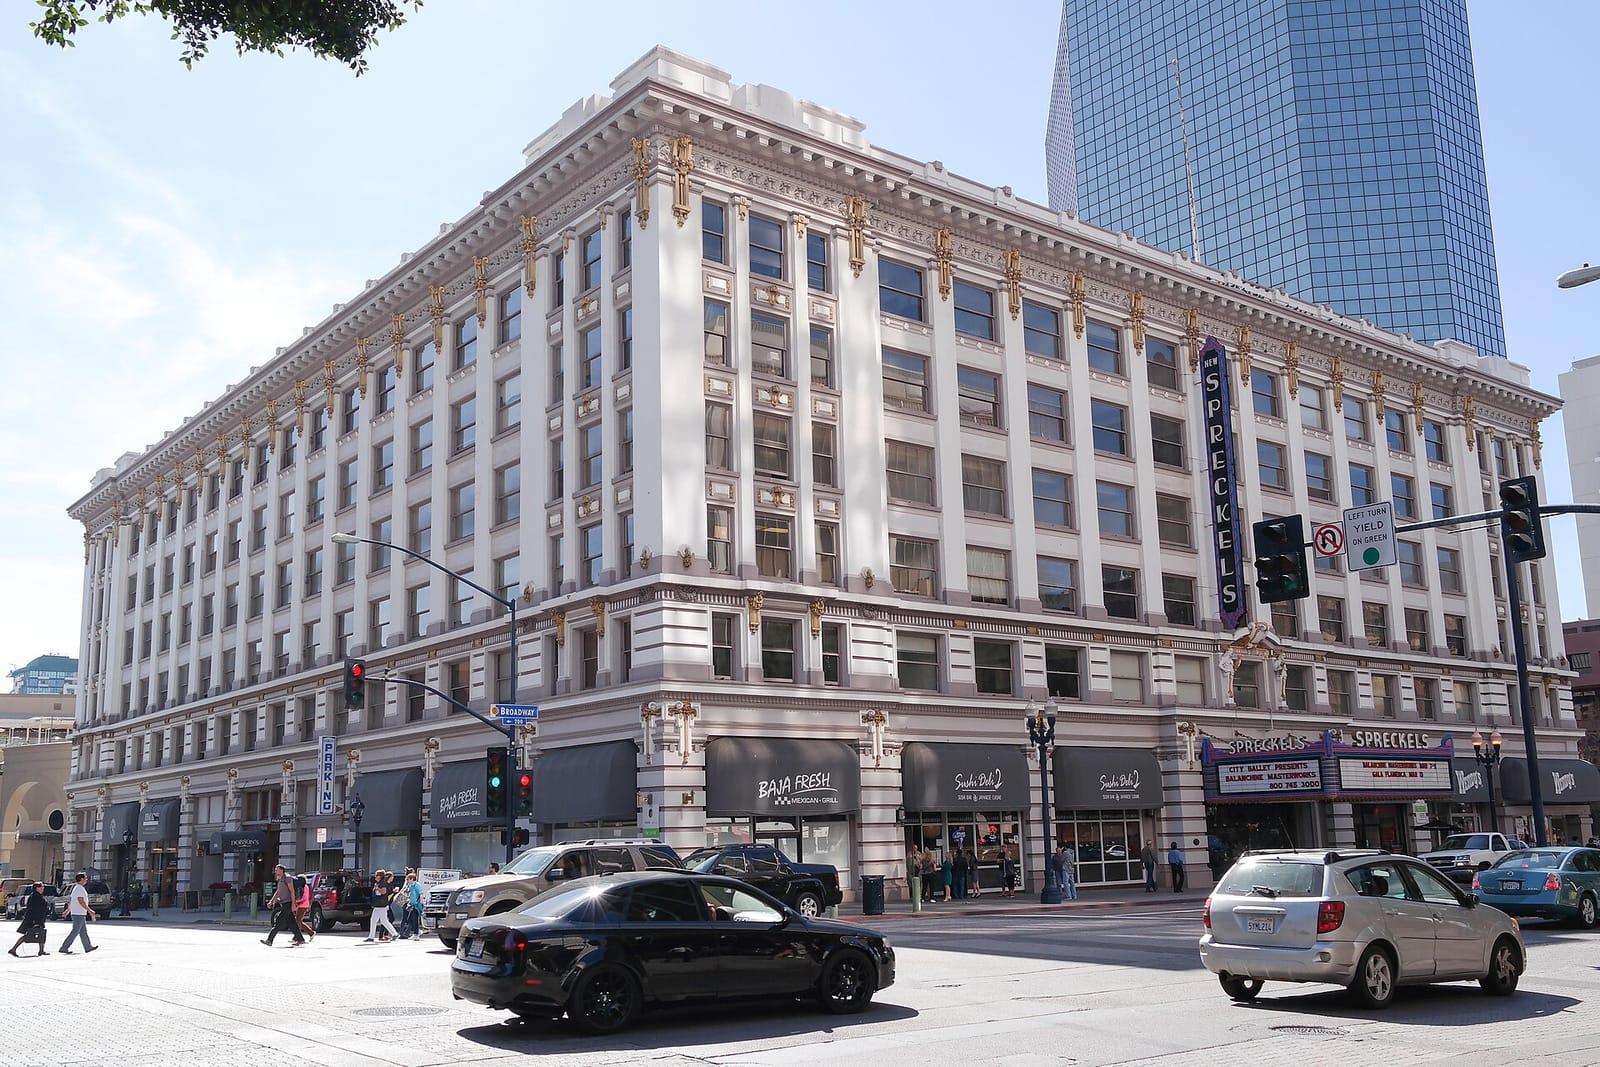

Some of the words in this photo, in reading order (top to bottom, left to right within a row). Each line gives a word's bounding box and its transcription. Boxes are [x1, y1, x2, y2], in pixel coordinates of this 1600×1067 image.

[1204, 356, 1218, 368] NEW
[1206, 373, 1237, 603] SPRECKELS
[1348, 511, 1364, 520] LEFT
[1368, 507, 1386, 517] TURN
[1354, 520, 1384, 533] YIELD
[1352, 538, 1362, 546] ON
[1365, 533, 1388, 544] GREEN
[500, 706, 535, 716] BROADWAY
[1228, 735, 1306, 755] SPRECKELS
[1356, 731, 1430, 749] SPRECKELS
[1247, 764, 1271, 772] BALLET
[1274, 762, 1308, 771] PRESENTS
[323, 743, 333, 810] PARKING
[758, 775, 791, 799] BAJA
[794, 772, 831, 790] FRESH
[954, 773, 978, 791] Sushi
[978, 772, 994, 787] Deli
[994, 768, 1003, 790] 2
[1099, 774, 1119, 791] Sushi
[1120, 773, 1133, 787] Deli
[1133, 769, 1141, 789] 2
[1225, 774, 1264, 782] BALANCHINE
[1267, 772, 1317, 780] MASTERWORKS
[440, 793, 457, 813] BAJA
[457, 787, 478, 804] FRESH
